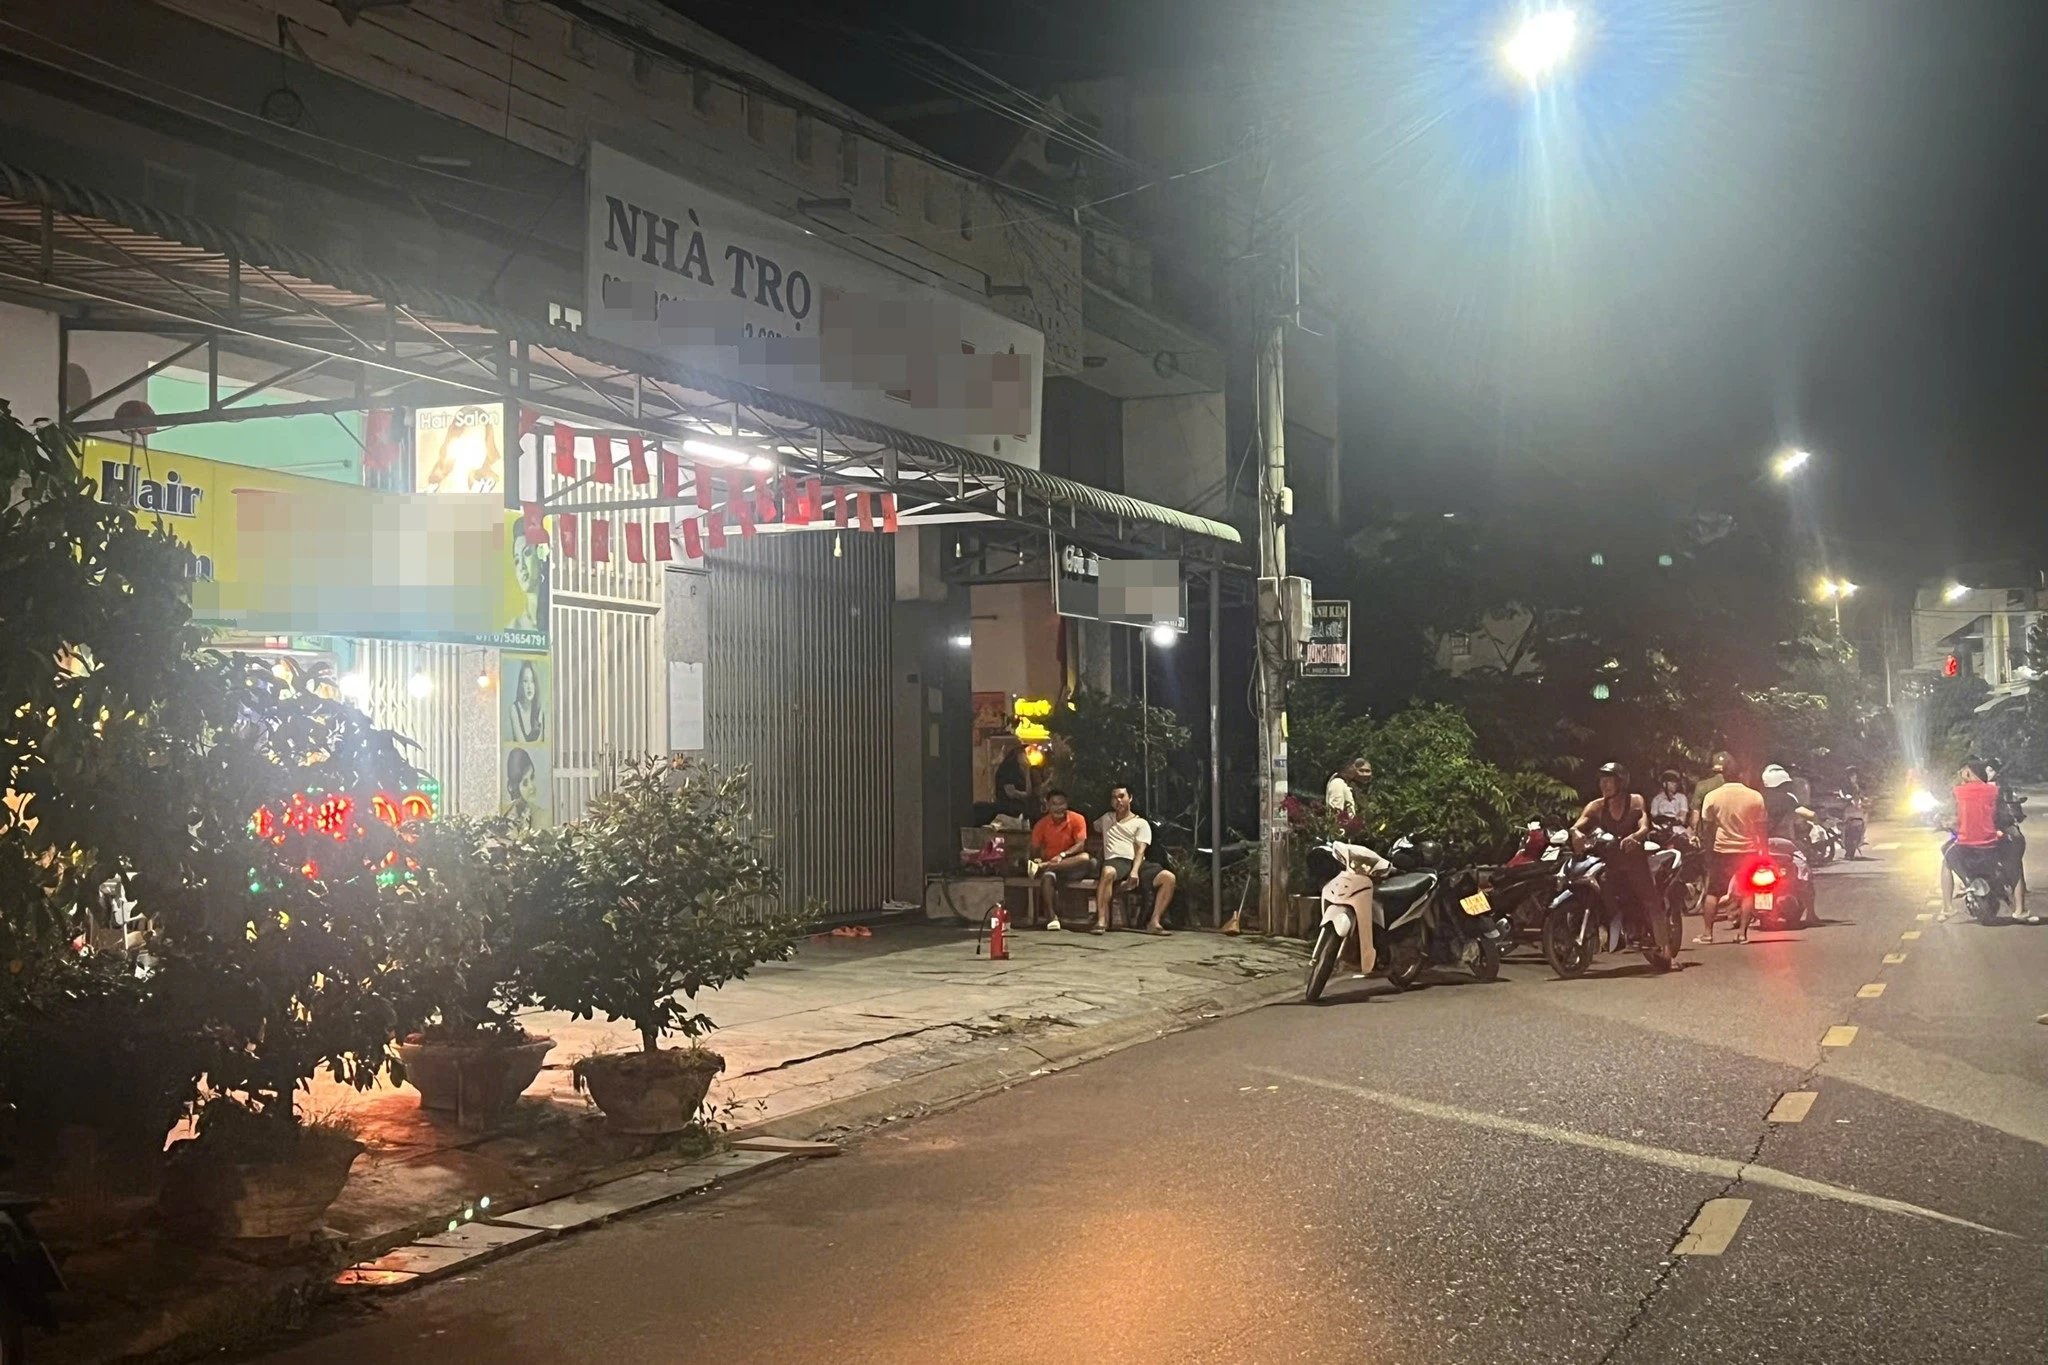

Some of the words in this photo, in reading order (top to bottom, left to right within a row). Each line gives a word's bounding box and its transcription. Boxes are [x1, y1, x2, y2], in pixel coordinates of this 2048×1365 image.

[605, 195, 714, 286] NHÀ
[725, 245, 811, 331] TRỌ
[420, 411, 452, 429] Hair
[454, 410, 500, 428] Salon
[100, 460, 204, 517] Hair
